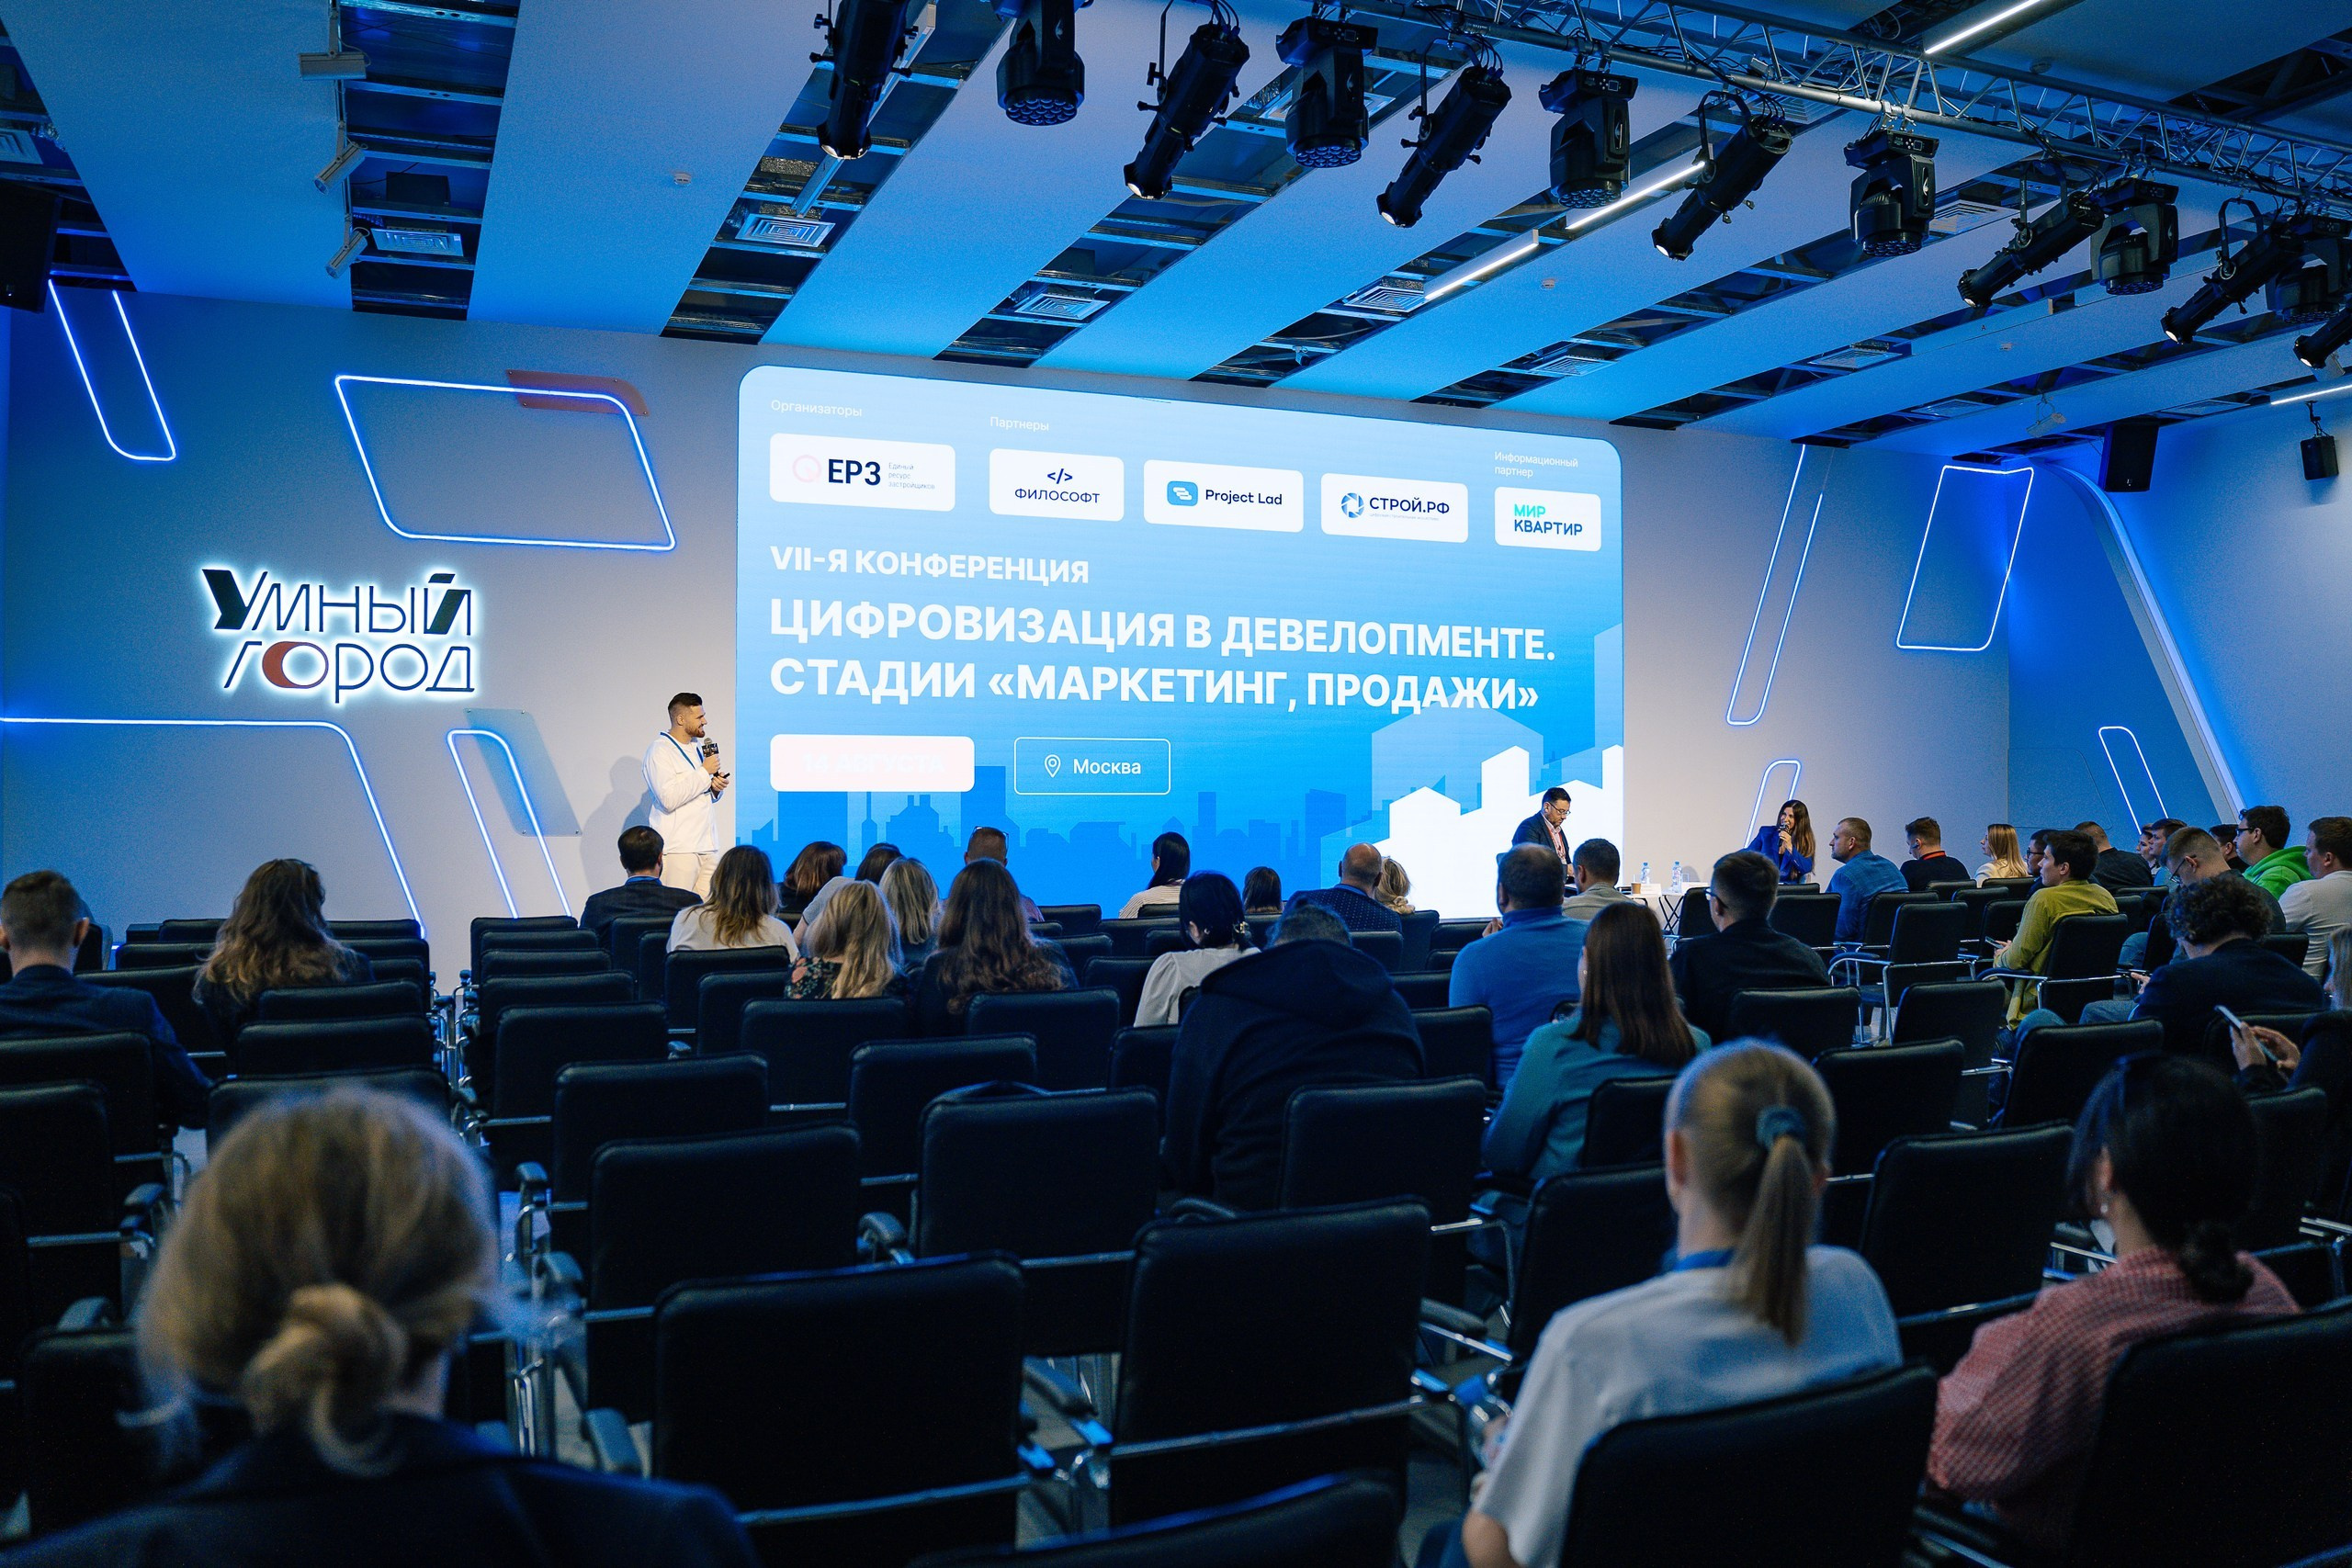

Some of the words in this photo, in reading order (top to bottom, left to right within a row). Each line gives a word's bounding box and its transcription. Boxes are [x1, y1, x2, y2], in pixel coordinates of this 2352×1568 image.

[771, 400, 863, 417] Организаторы
[989, 416, 1049, 433] Партнеры
[1494, 451, 1578, 468] Информационный
[828, 458, 882, 487] ЕРЗ
[1494, 465, 1533, 479] партнер
[1014, 488, 1101, 504] ФИЛОСОФТ
[1205, 489, 1254, 507] Project
[1258, 492, 1283, 506] Lad
[1369, 497, 1450, 514] СТРОЙ.РФ
[1513, 503, 1546, 518] МИР
[1513, 519, 1583, 536] КВАРТИР
[770, 546, 847, 573] VII-Я
[855, 549, 1089, 587] КОНФЕРЕНЦИЯ
[770, 598, 1175, 653] ЦИФРОВИЗАЦИЯ
[1186, 614, 1212, 649] В
[1220, 615, 1555, 661] ДЕВЕЛОПМЕНТЕ.
[770, 657, 976, 705] СТАДИИ
[989, 663, 1297, 713] «МАРКЕТИНГ,
[1307, 671, 1539, 716] ПРОДАЖИ»
[1073, 759, 1142, 774] Москва
